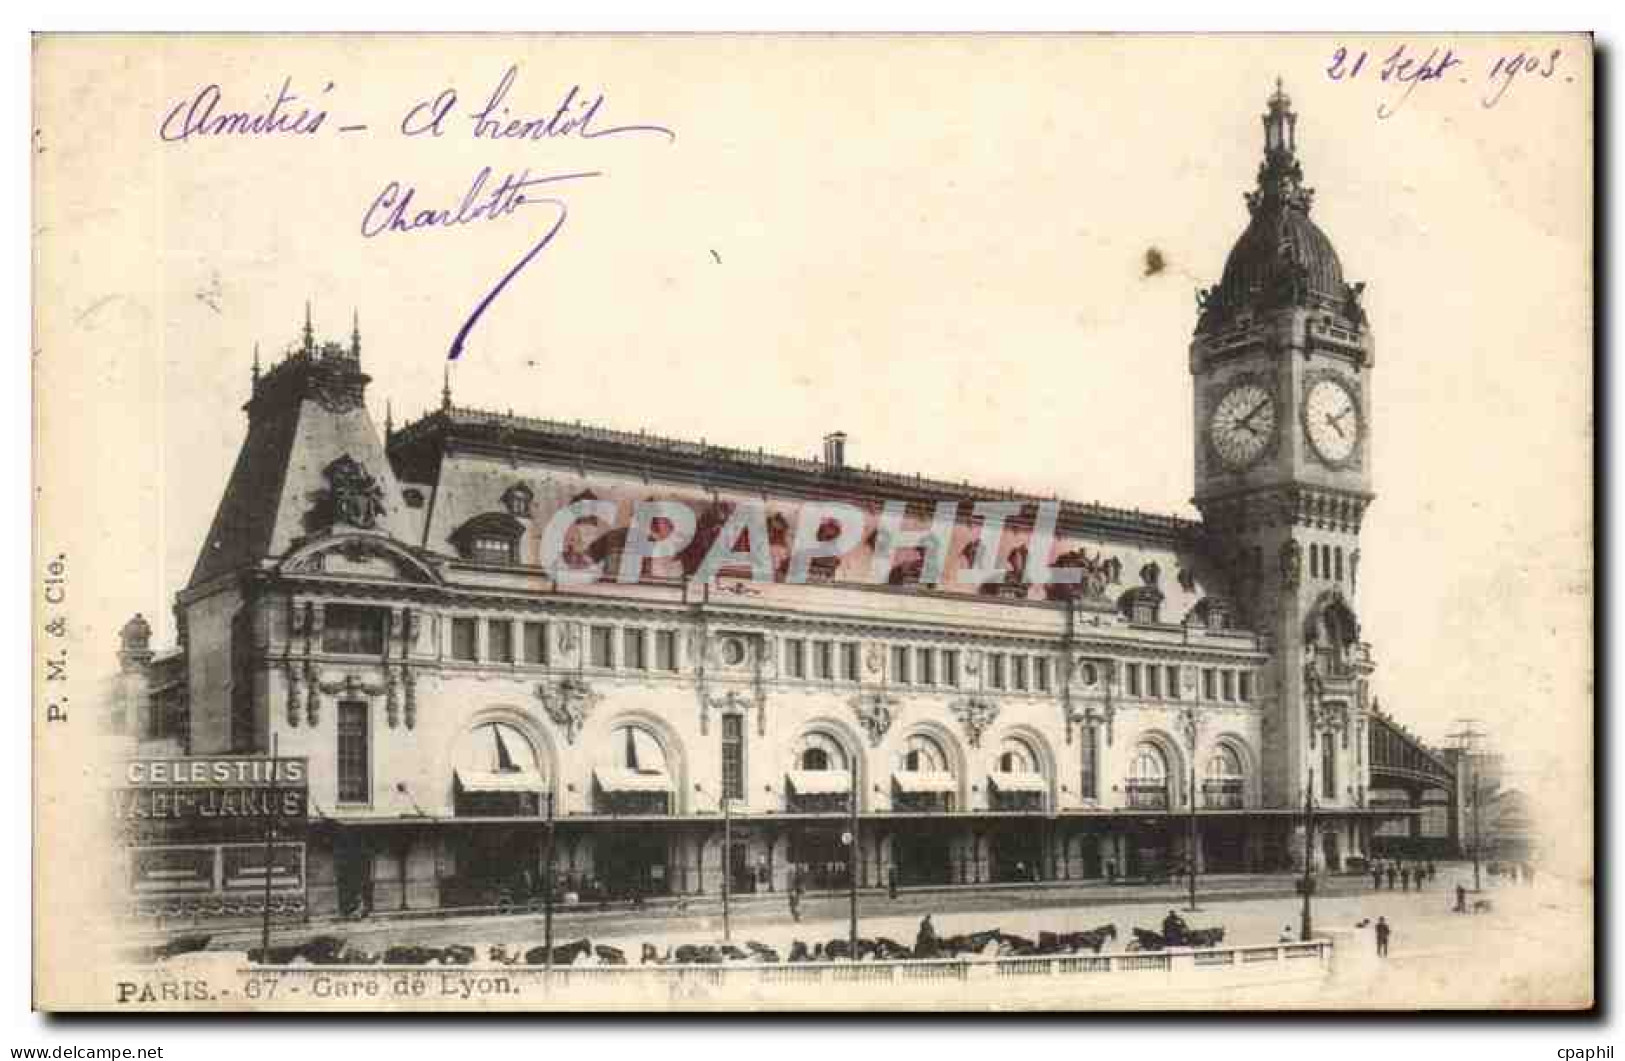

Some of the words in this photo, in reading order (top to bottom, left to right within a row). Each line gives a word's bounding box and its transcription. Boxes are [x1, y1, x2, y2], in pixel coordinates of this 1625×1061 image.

[1327, 46, 1368, 80] 21
[45, 617, 66, 637] &
[47, 649, 67, 681] M.
[47, 697, 68, 722] P.
[244, 979, 279, 999] 67
[312, 977, 378, 998] Gare
[393, 975, 426, 996] de
[439, 974, 520, 999] Lyon.
